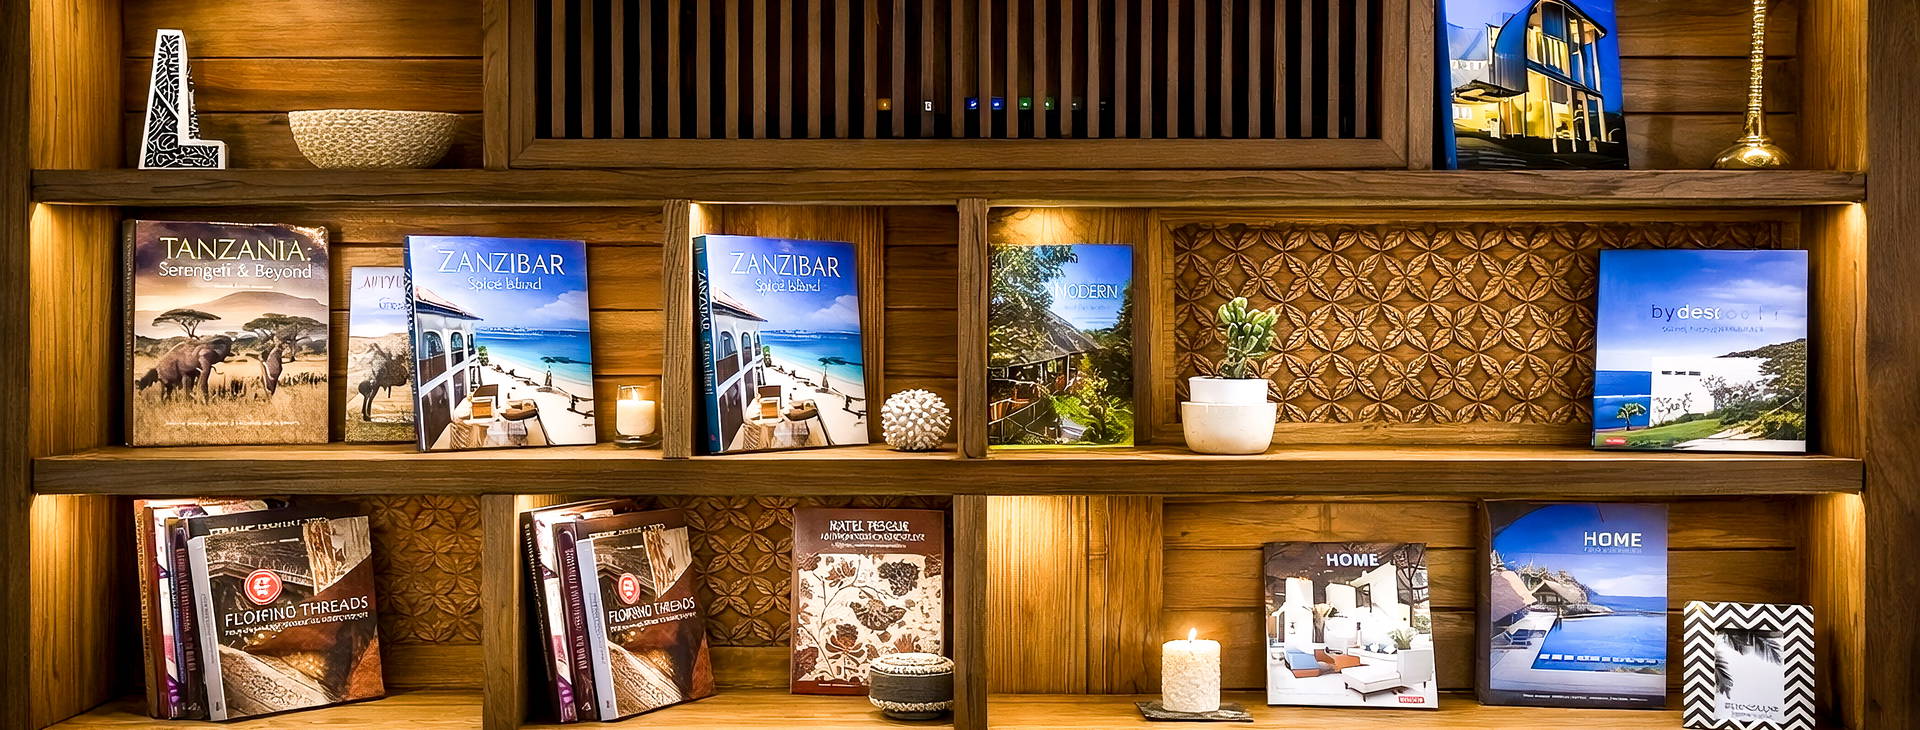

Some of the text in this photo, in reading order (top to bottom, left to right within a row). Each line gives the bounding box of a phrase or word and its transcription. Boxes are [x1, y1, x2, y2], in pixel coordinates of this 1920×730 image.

[159, 236, 312, 261] TANZANIA:
[236, 264, 249, 278] &
[255, 263, 312, 282] Beyond
[437, 249, 565, 276] ZANZIBAR
[729, 251, 841, 278] ZANZIBAR
[1054, 283, 1118, 299] MODERN
[1583, 531, 1643, 547] HOME
[1326, 553, 1380, 567] HOME
[299, 595, 369, 616] THREADS
